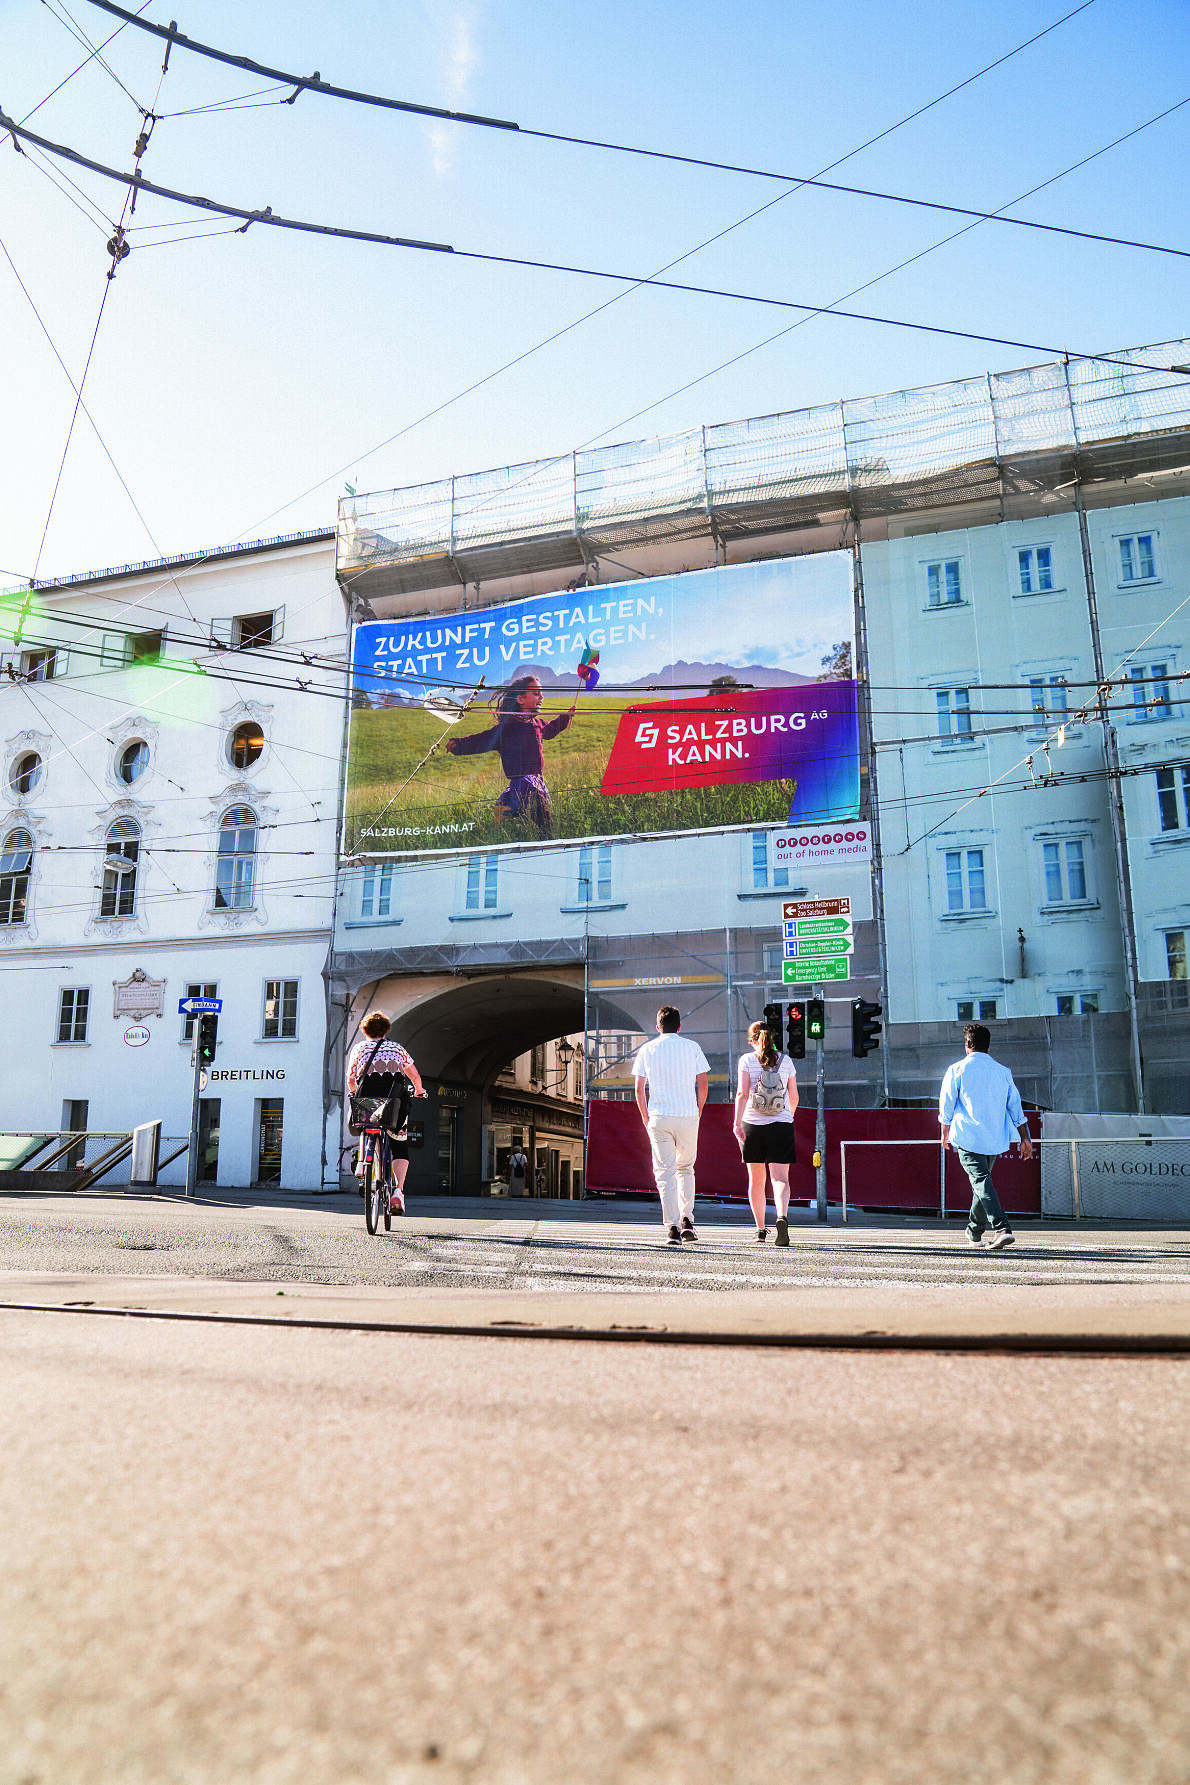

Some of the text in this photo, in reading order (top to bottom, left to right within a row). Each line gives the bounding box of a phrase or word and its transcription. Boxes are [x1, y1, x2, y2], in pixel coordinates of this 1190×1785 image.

[375, 596, 664, 656] ZUKUNFT GESTALTEN,
[373, 622, 655, 678] STATT ZU VERTAGEN.
[666, 709, 828, 744] SALZBURG AG
[668, 740, 750, 765] KANN.
[360, 822, 476, 837] SALZBURG-KANN.AT
[776, 830, 867, 848] progress
[777, 844, 867, 860] out of home media
[796, 902, 815, 910] Schloss
[806, 908, 828, 916] Salzburg
[785, 923, 796, 937] H
[786, 942, 797, 956] H
[633, 976, 681, 986] XERVON
[210, 1069, 286, 1081] BREITLING
[1090, 1160, 1116, 1174] AM
